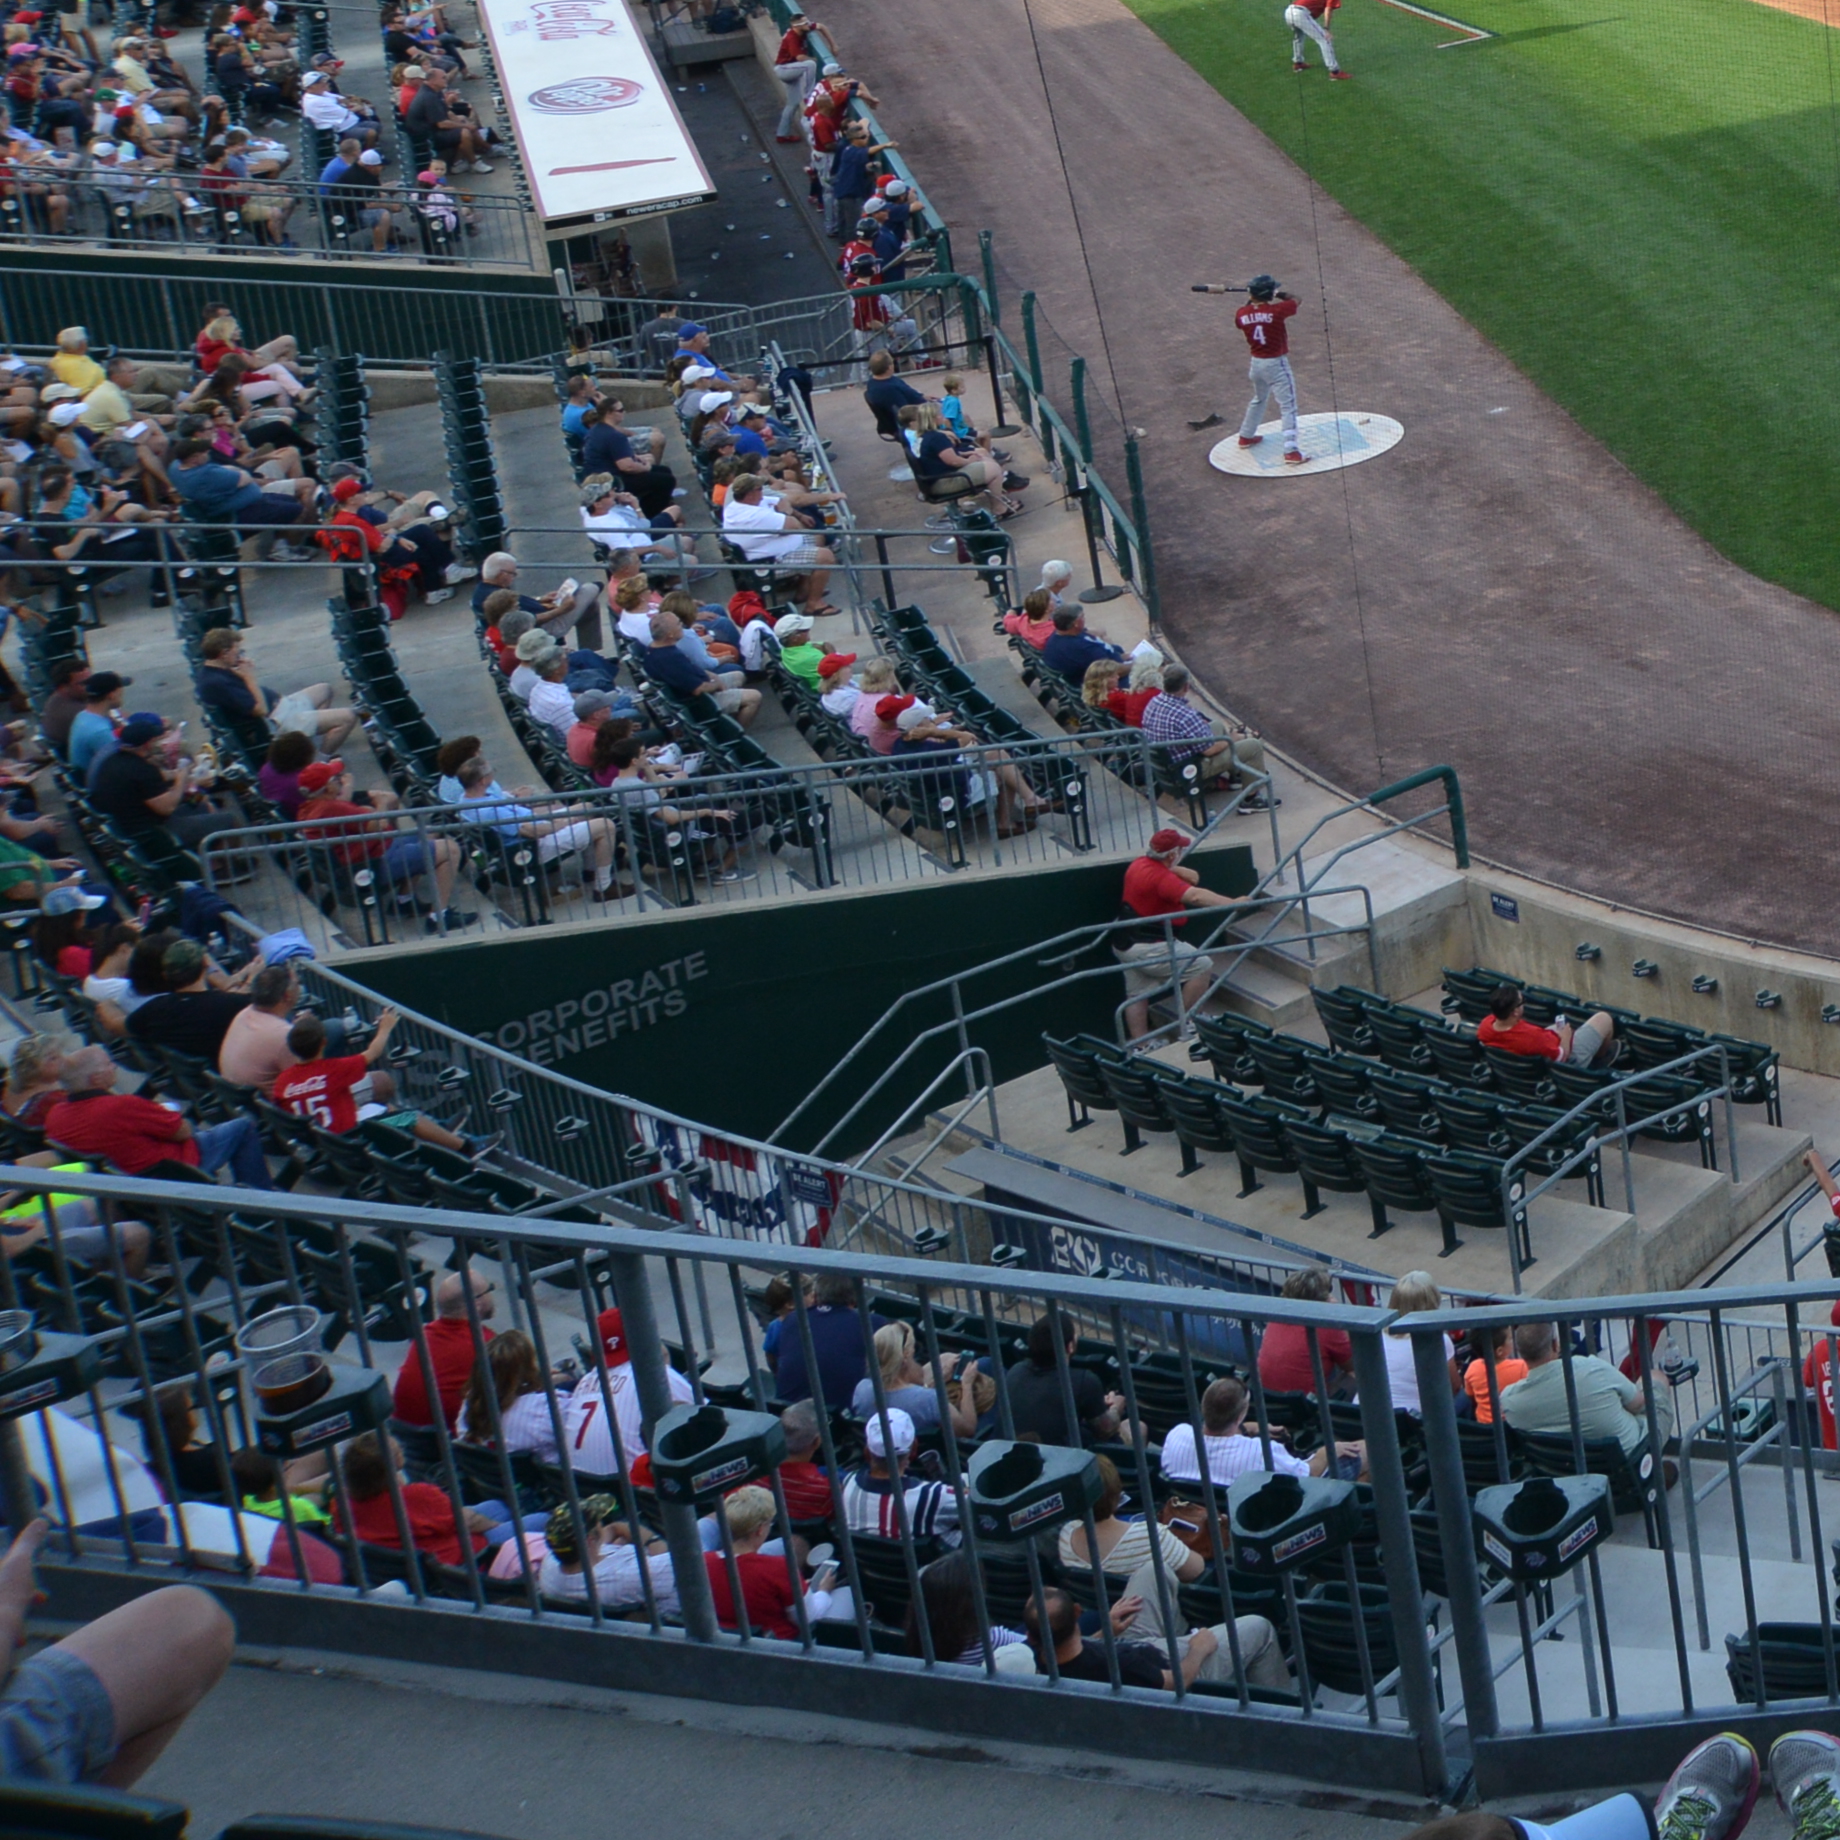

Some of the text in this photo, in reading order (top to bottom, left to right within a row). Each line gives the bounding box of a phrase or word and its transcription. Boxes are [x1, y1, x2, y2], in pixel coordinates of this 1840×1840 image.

[626, 195, 703, 216] neweracap.com
[1253, 325, 1267, 345] 4
[290, 1097, 333, 1129] 15
[574, 1400, 598, 1450] 7
